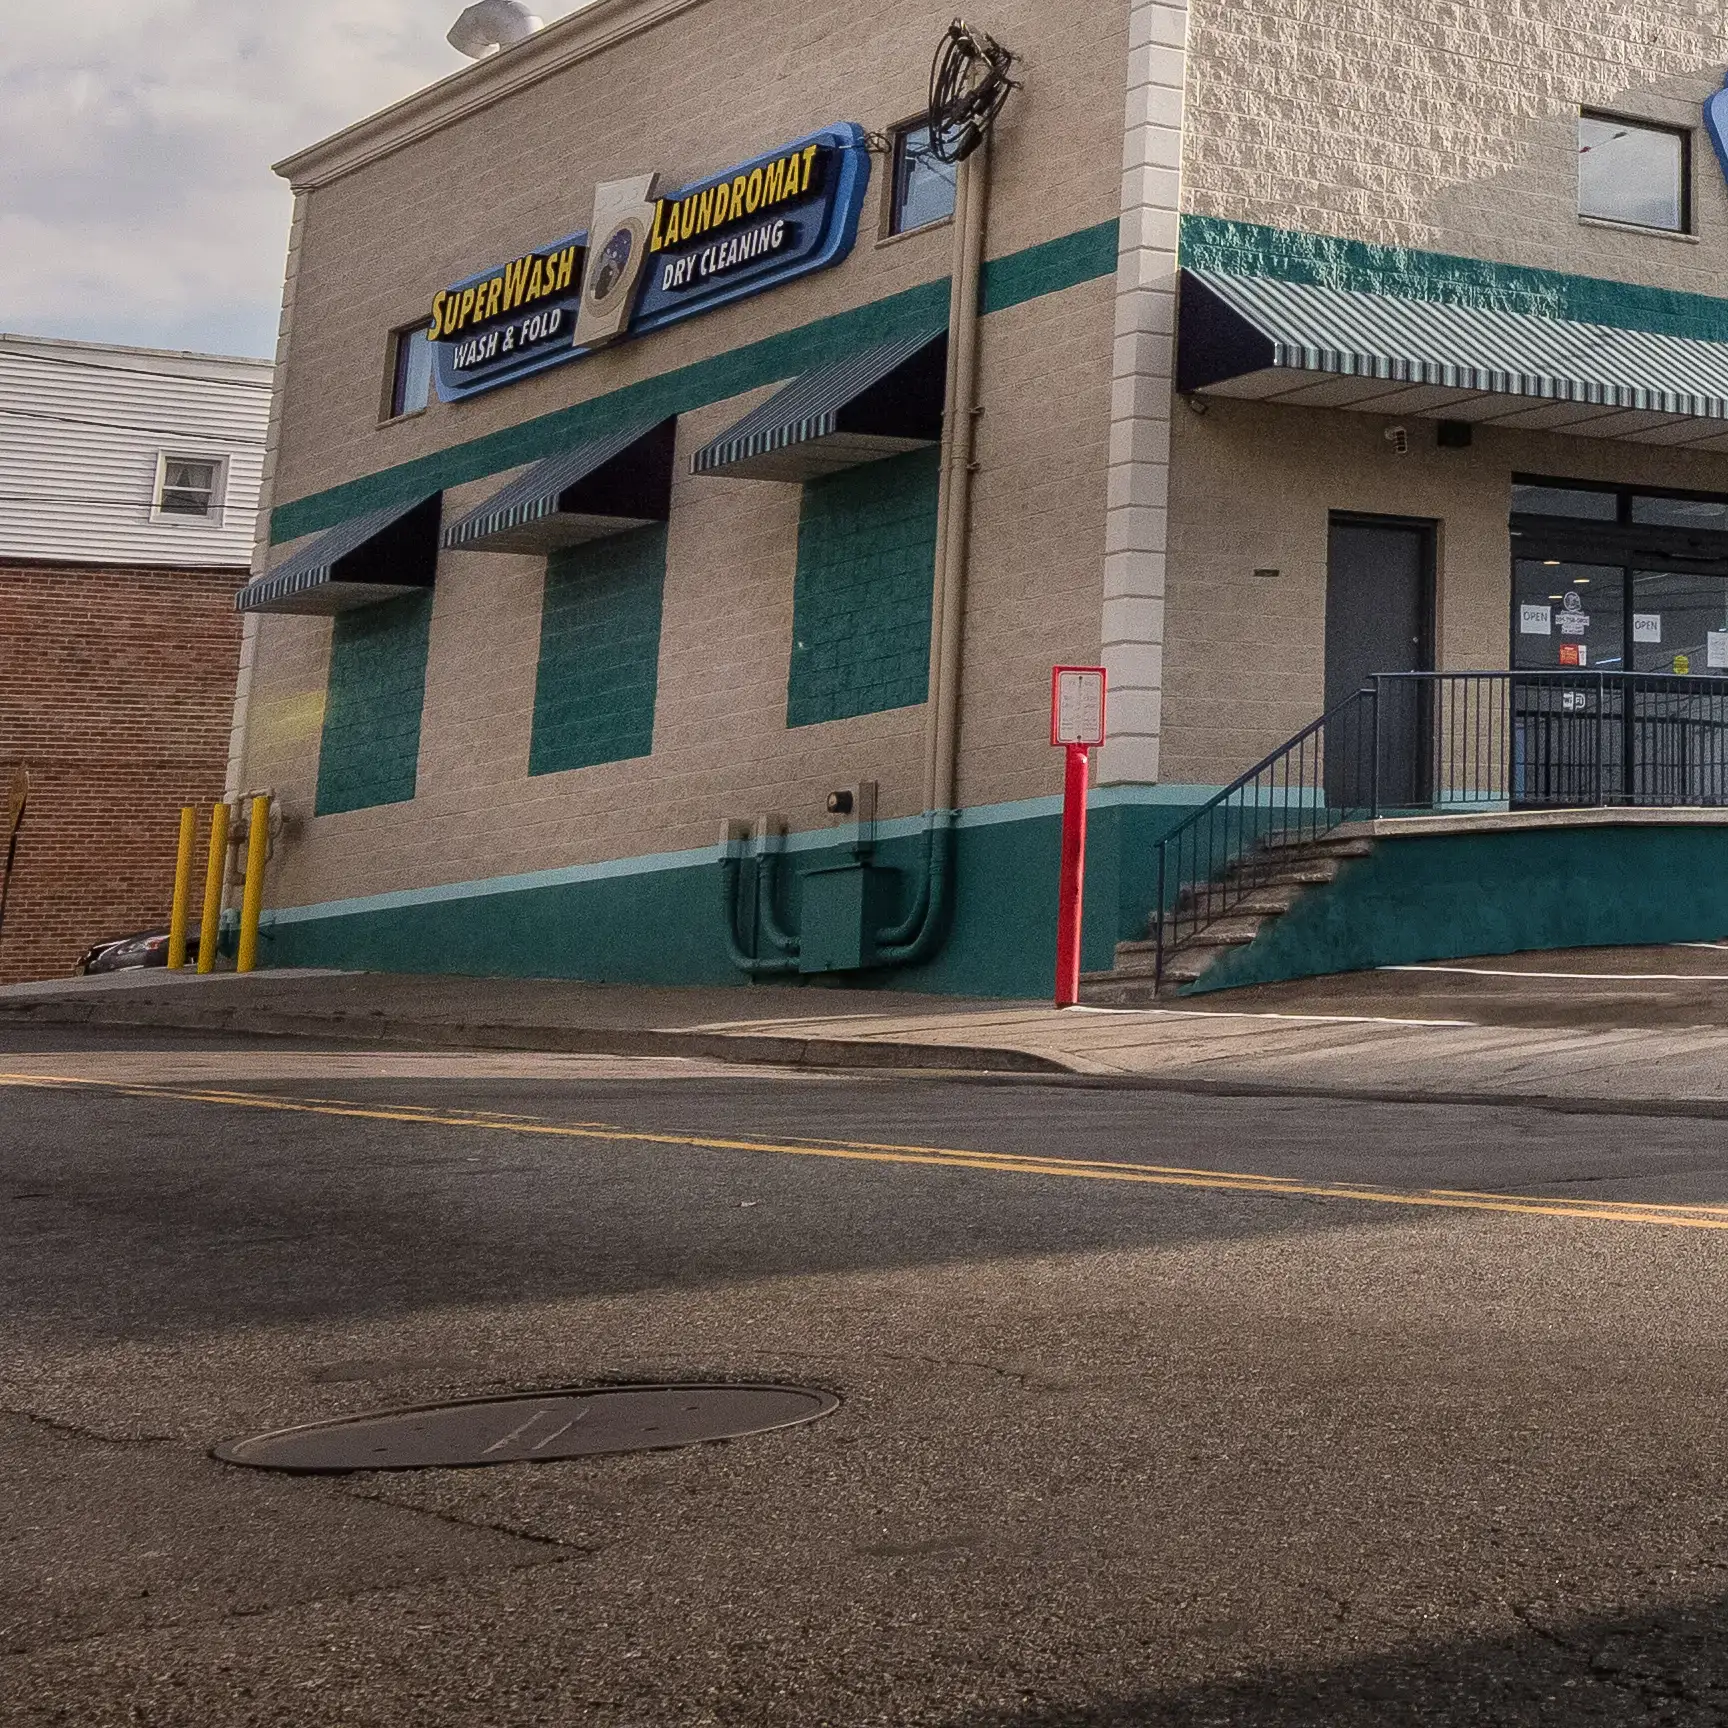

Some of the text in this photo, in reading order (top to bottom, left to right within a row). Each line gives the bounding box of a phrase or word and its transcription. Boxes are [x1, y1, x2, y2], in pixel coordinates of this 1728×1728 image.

[650, 144, 817, 253] LAUNDROMAT
[662, 219, 784, 291] DRY CLEANING
[452, 307, 562, 370] WASH & FOLD
[1523, 610, 1548, 623] OPEN
[1634, 620, 1658, 632] OPEN
